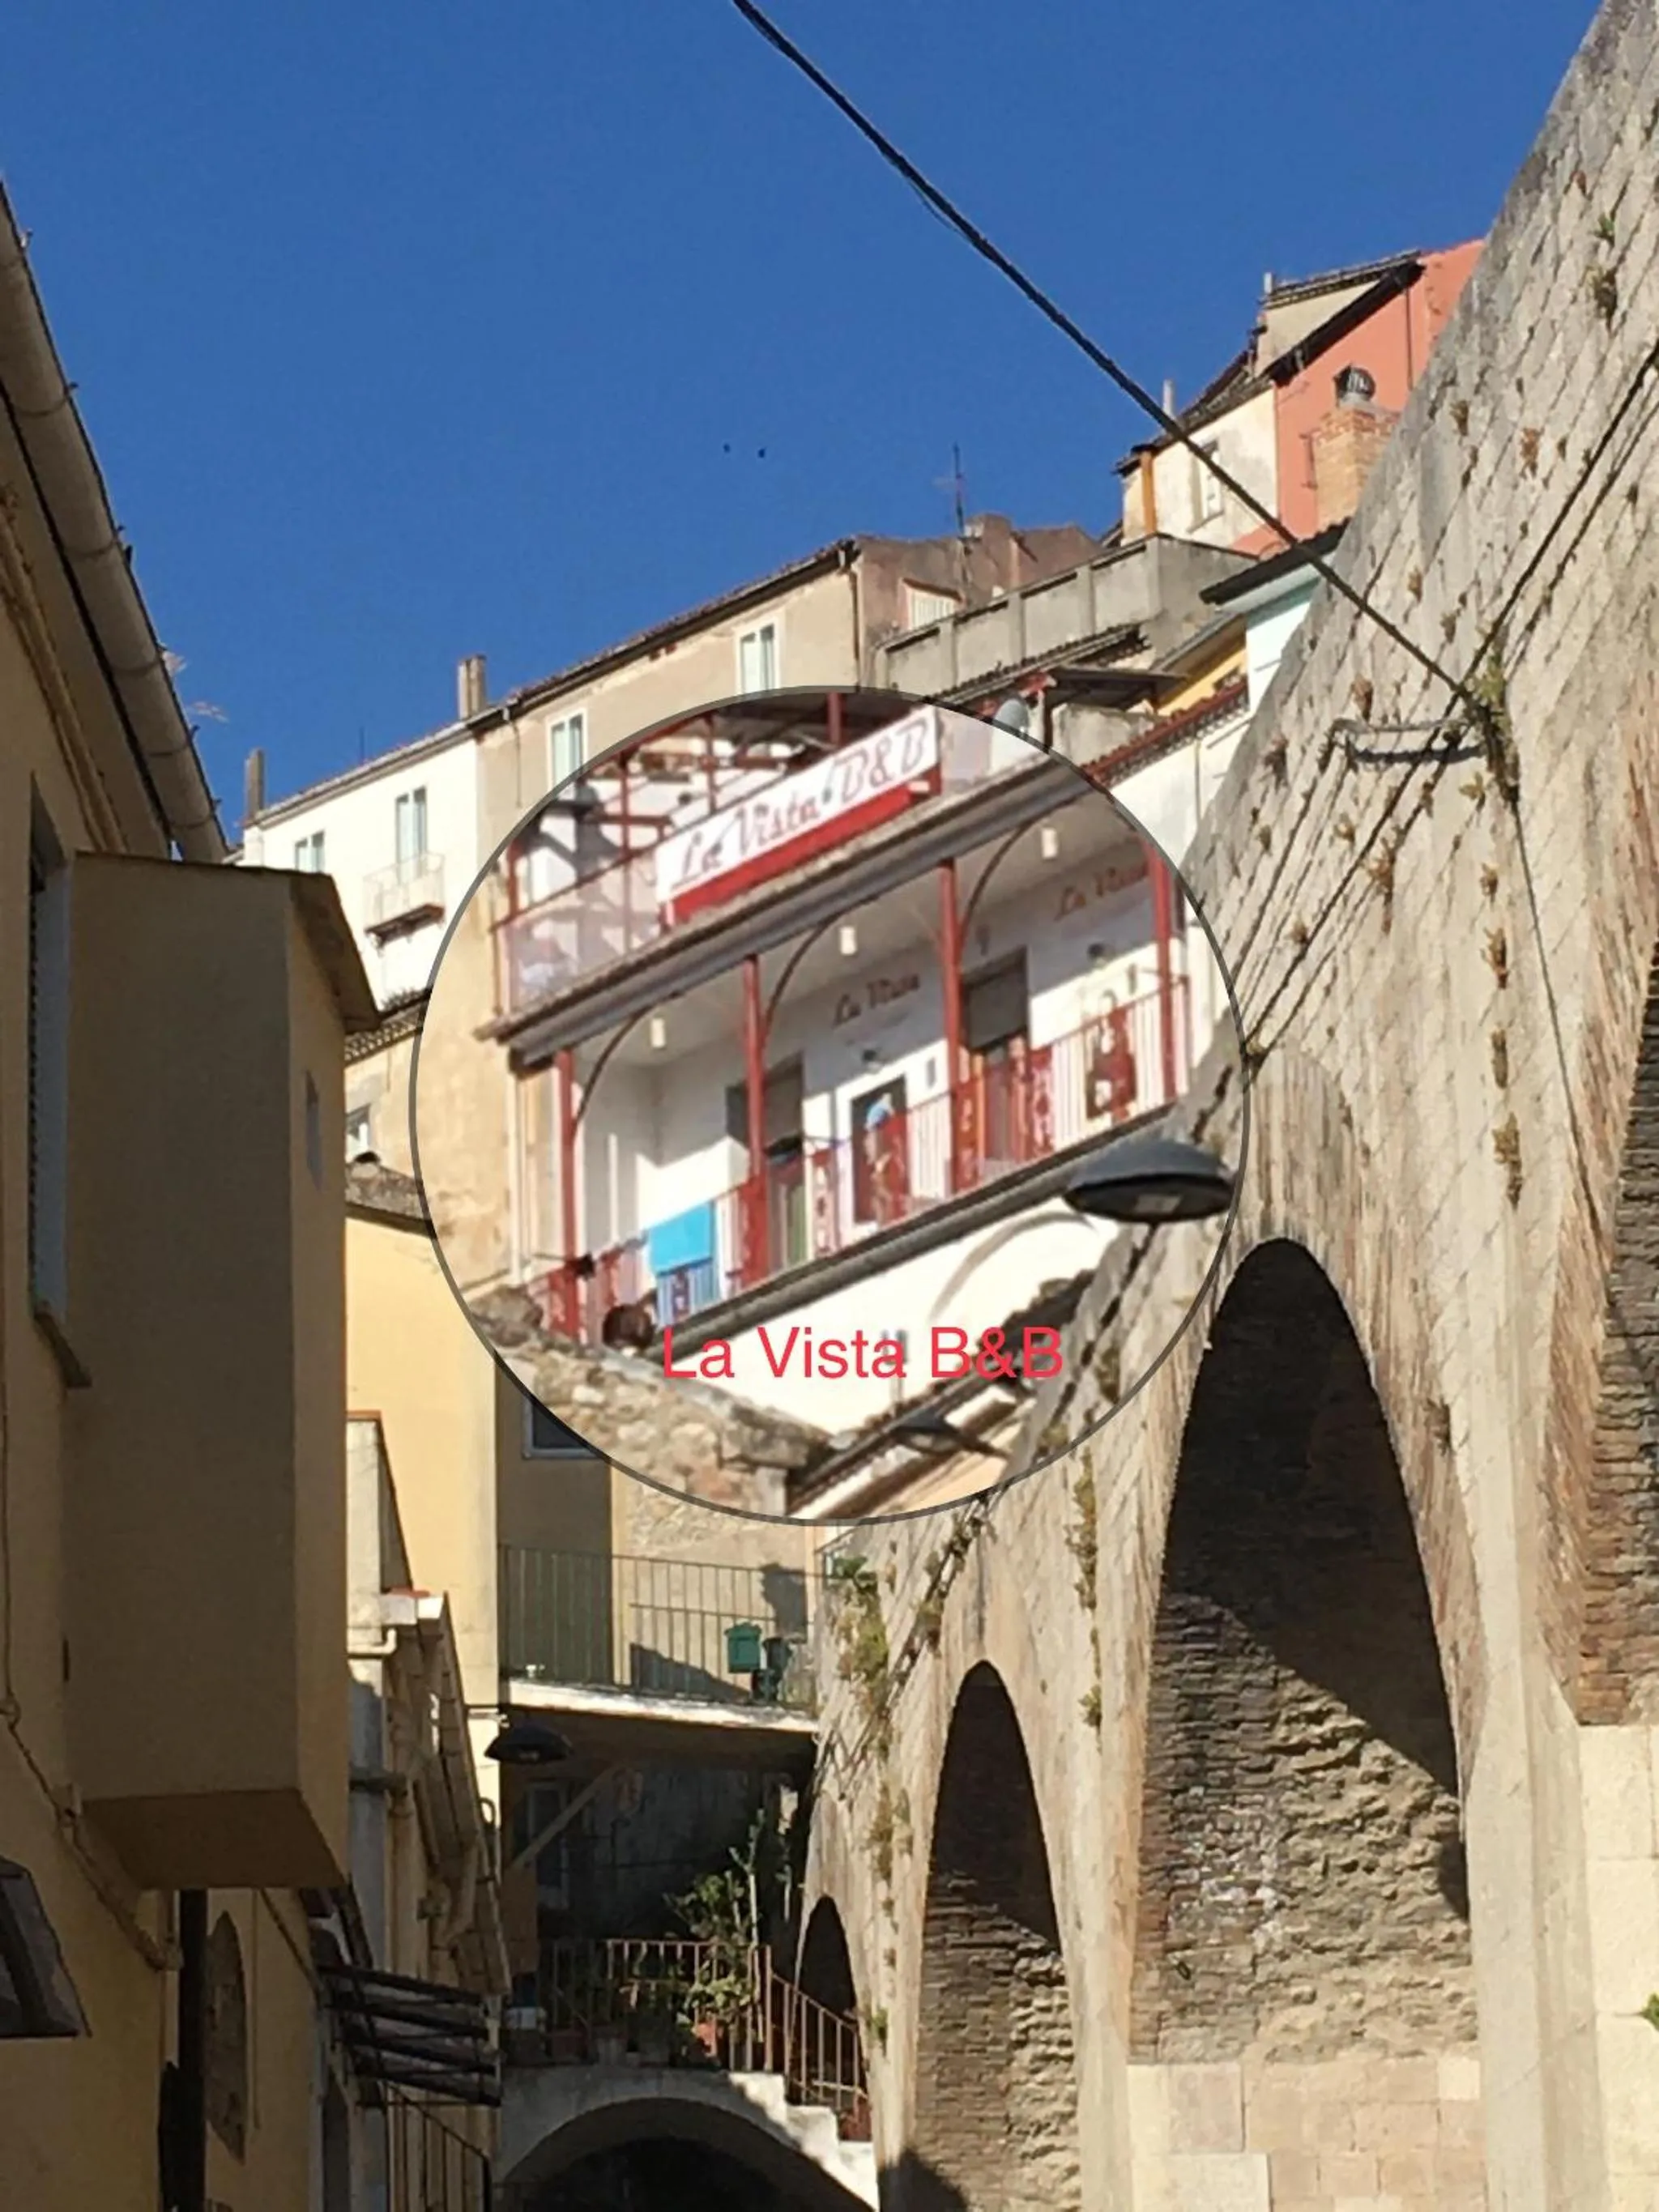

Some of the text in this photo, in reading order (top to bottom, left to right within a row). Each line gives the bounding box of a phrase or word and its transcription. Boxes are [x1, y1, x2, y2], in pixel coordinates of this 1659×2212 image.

[669, 718, 928, 889] La Vista B&B
